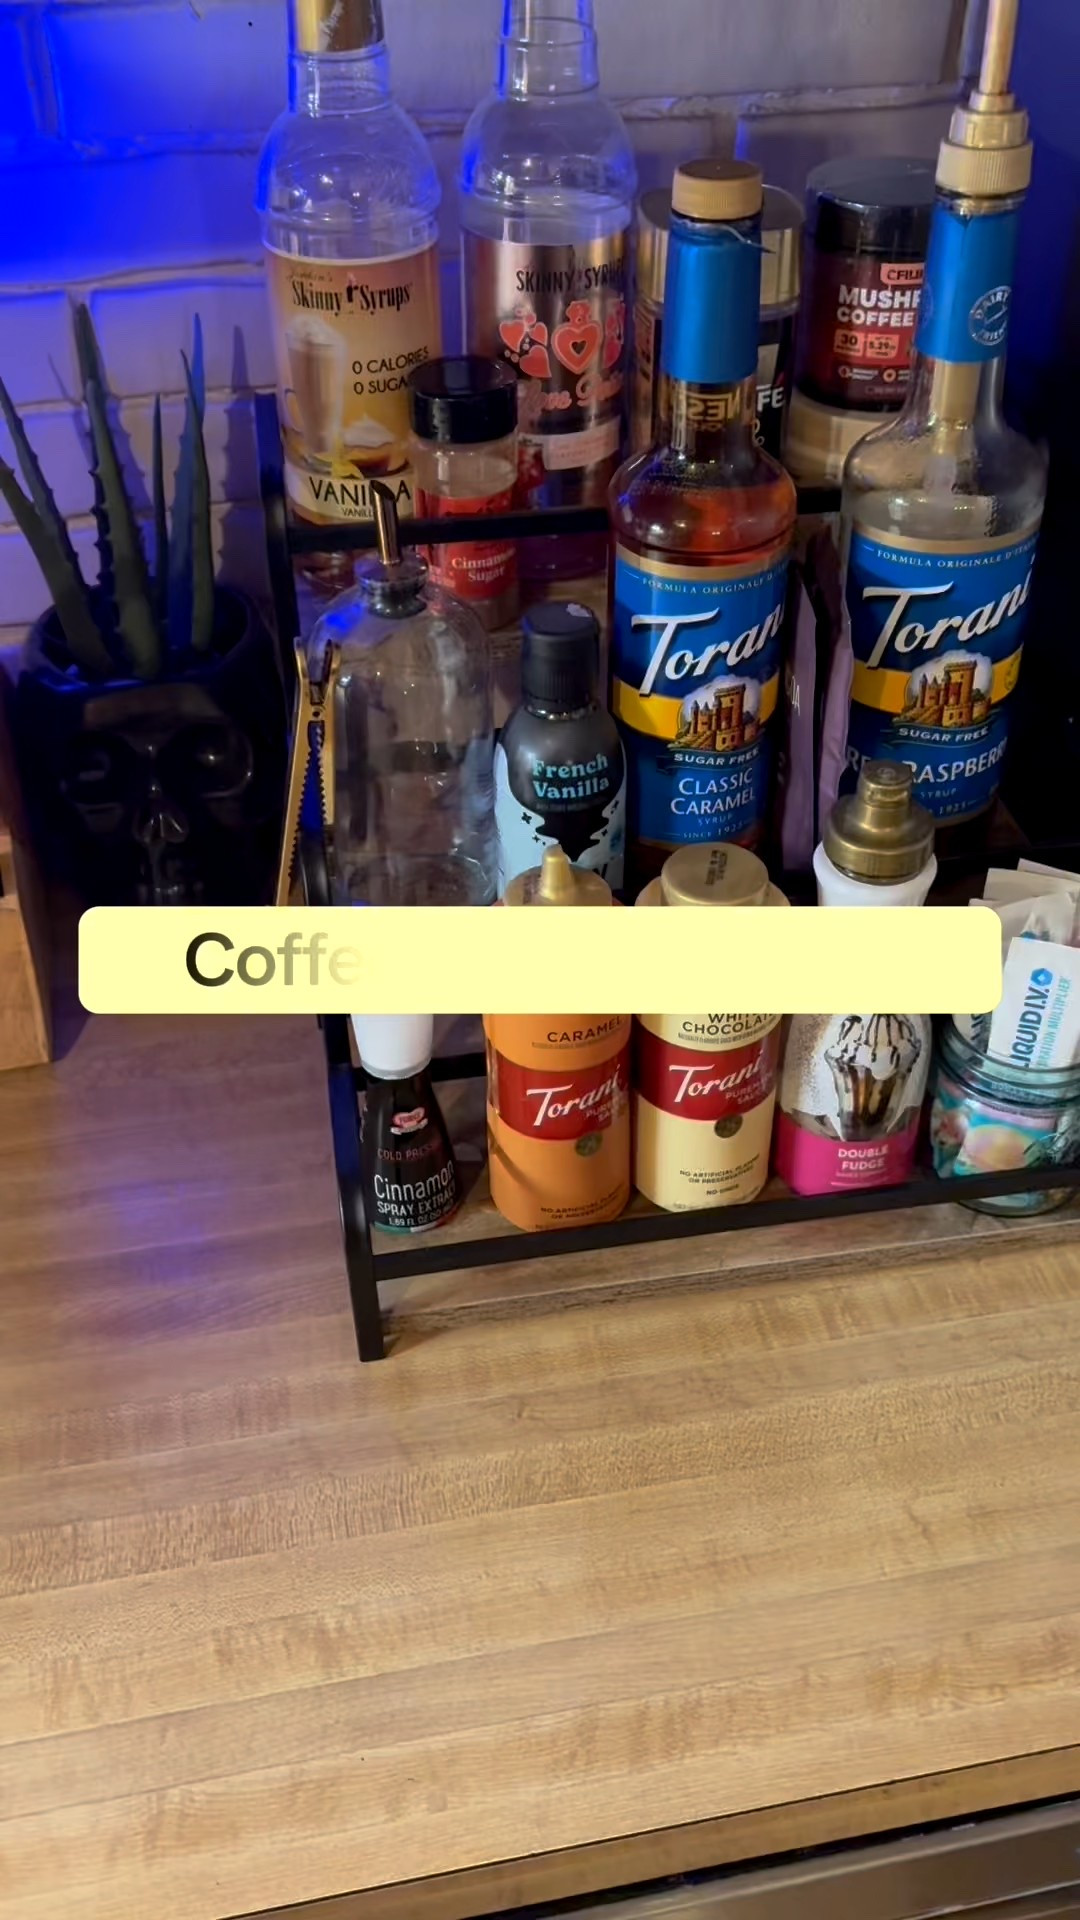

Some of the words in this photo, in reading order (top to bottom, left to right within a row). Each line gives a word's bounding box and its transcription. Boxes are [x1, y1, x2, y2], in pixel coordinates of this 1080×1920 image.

[516, 270, 575, 292] SKINNY
[291, 280, 343, 316] Skinny
[359, 282, 411, 315] Syrups
[837, 306, 915, 327] COFFEE
[840, 333, 858, 346] 30
[366, 345, 430, 374] CALORIES
[308, 476, 411, 506] VANIA
[342, 507, 374, 518] VANILL
[877, 549, 931, 567] FORMULA
[937, 554, 1001, 568] ORIGINALE
[643, 577, 697, 594] FORMULA
[862, 553, 1036, 670] Torani
[898, 727, 951, 743] SUGAR
[955, 725, 989, 743] FREE
[532, 753, 609, 779] French
[673, 752, 725, 767] SUGAR
[728, 748, 760, 764] FREE
[532, 776, 610, 799] Vanilla
[679, 767, 753, 796] CLASSIC
[670, 785, 756, 816] CARAMEL
[697, 812, 733, 826] SYRUP
[682, 1014, 774, 1036] CHOCOLA
[1010, 1010, 1043, 1069] IQUID
[669, 1048, 764, 1103] Torani
[525, 1063, 621, 1127] Torani
[377, 1147, 401, 1161] COLD
[837, 1144, 889, 1159] DOUBLE
[680, 1169, 691, 1178] NO
[693, 1168, 733, 1178] ARTIFICIAL
[841, 1157, 885, 1171] FUDGE
[373, 1160, 455, 1201] Cinnamon
[688, 1176, 700, 1184] OR
[376, 1200, 414, 1216] SPRAY
[540, 1206, 553, 1214] NO
